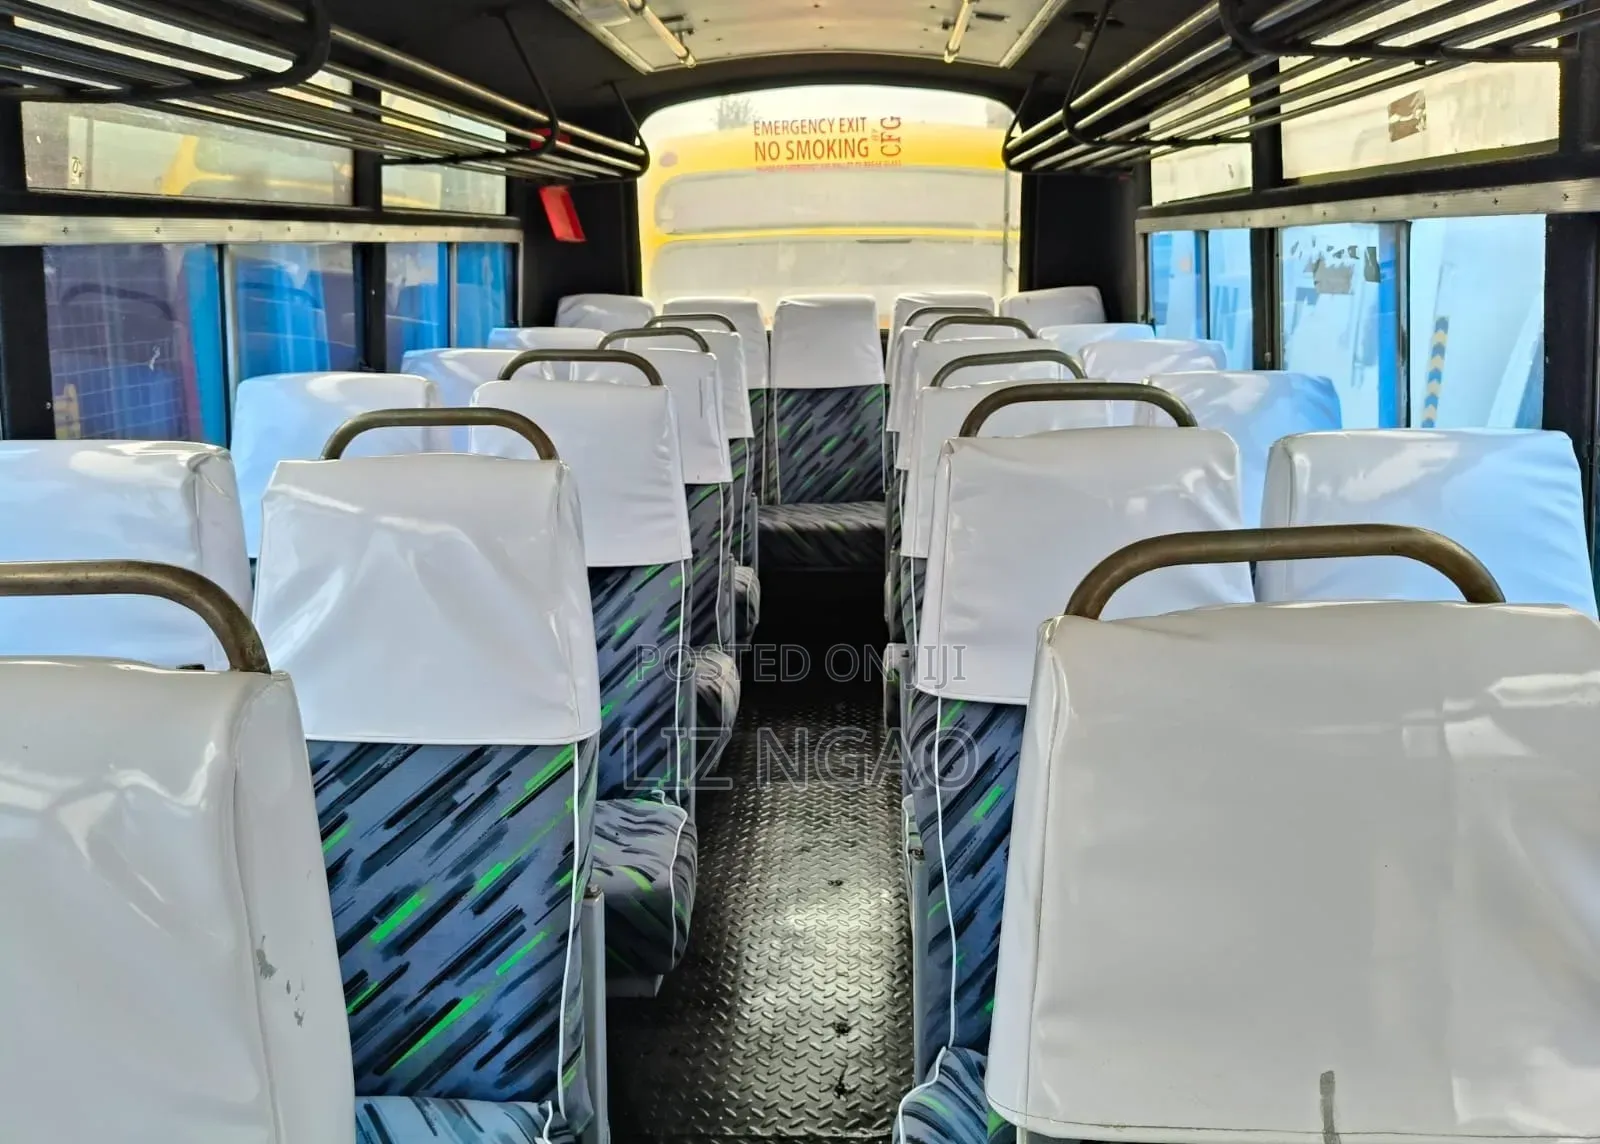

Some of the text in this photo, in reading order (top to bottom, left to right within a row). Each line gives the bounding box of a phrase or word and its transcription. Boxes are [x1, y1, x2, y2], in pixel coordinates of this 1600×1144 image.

[753, 116, 867, 136] EMERGENCY EXIT
[880, 115, 901, 157] CFG
[754, 137, 869, 162] NO SMOKING
